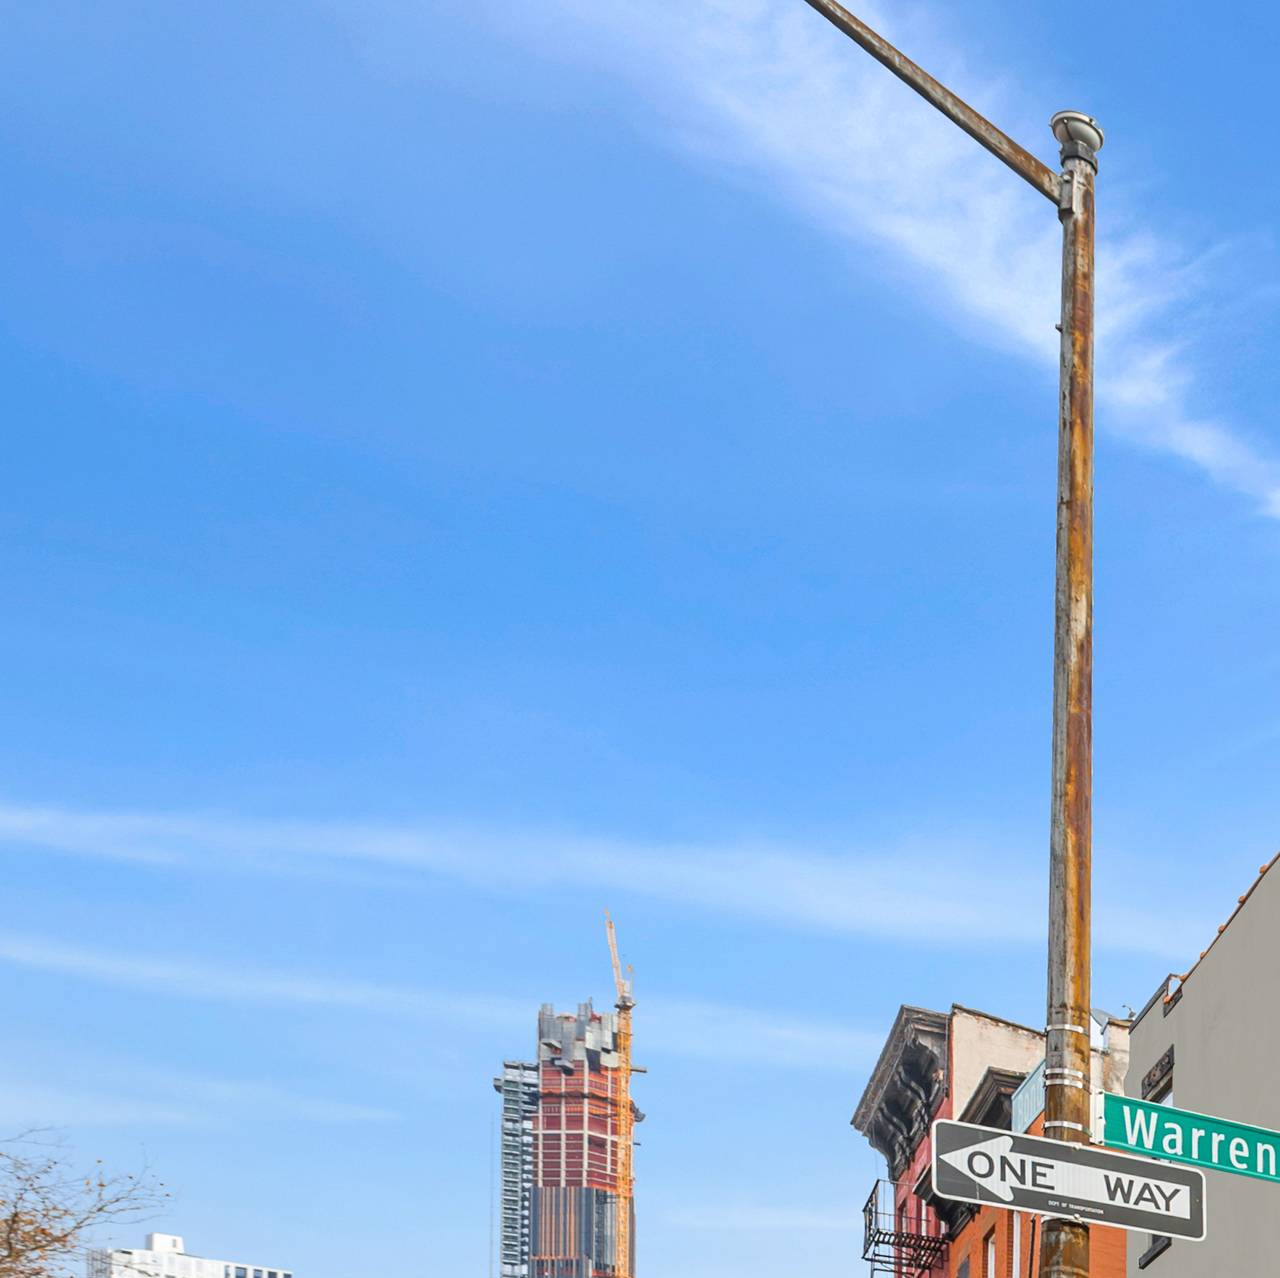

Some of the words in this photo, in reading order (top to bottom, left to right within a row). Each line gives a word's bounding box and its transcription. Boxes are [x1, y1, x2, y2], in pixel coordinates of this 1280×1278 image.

[1122, 1105, 1277, 1176] Warren
[967, 1150, 1055, 1191] ONE
[1103, 1174, 1182, 1212] WAY
